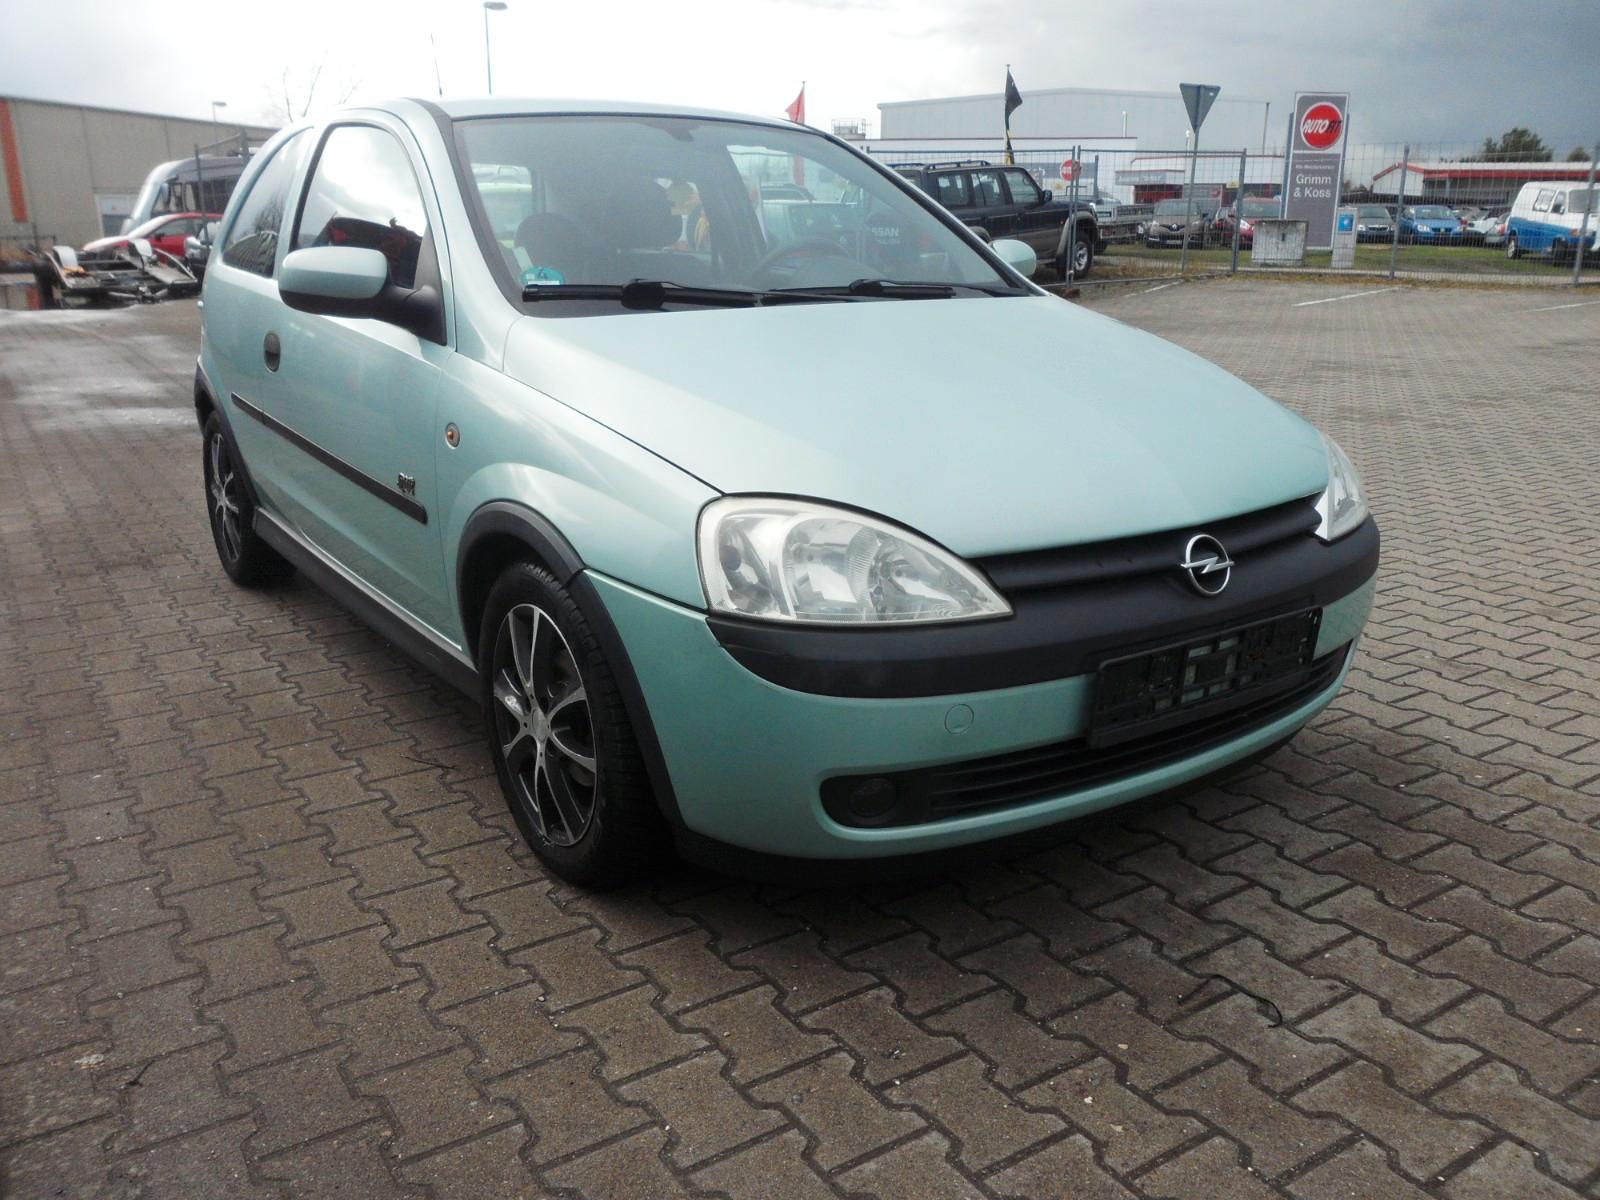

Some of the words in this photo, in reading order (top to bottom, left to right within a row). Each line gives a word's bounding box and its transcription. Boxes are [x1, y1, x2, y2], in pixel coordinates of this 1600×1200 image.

[1296, 174, 1331, 184] Grimm
[1293, 187, 1301, 198] &
[1304, 187, 1331, 198] Koss
